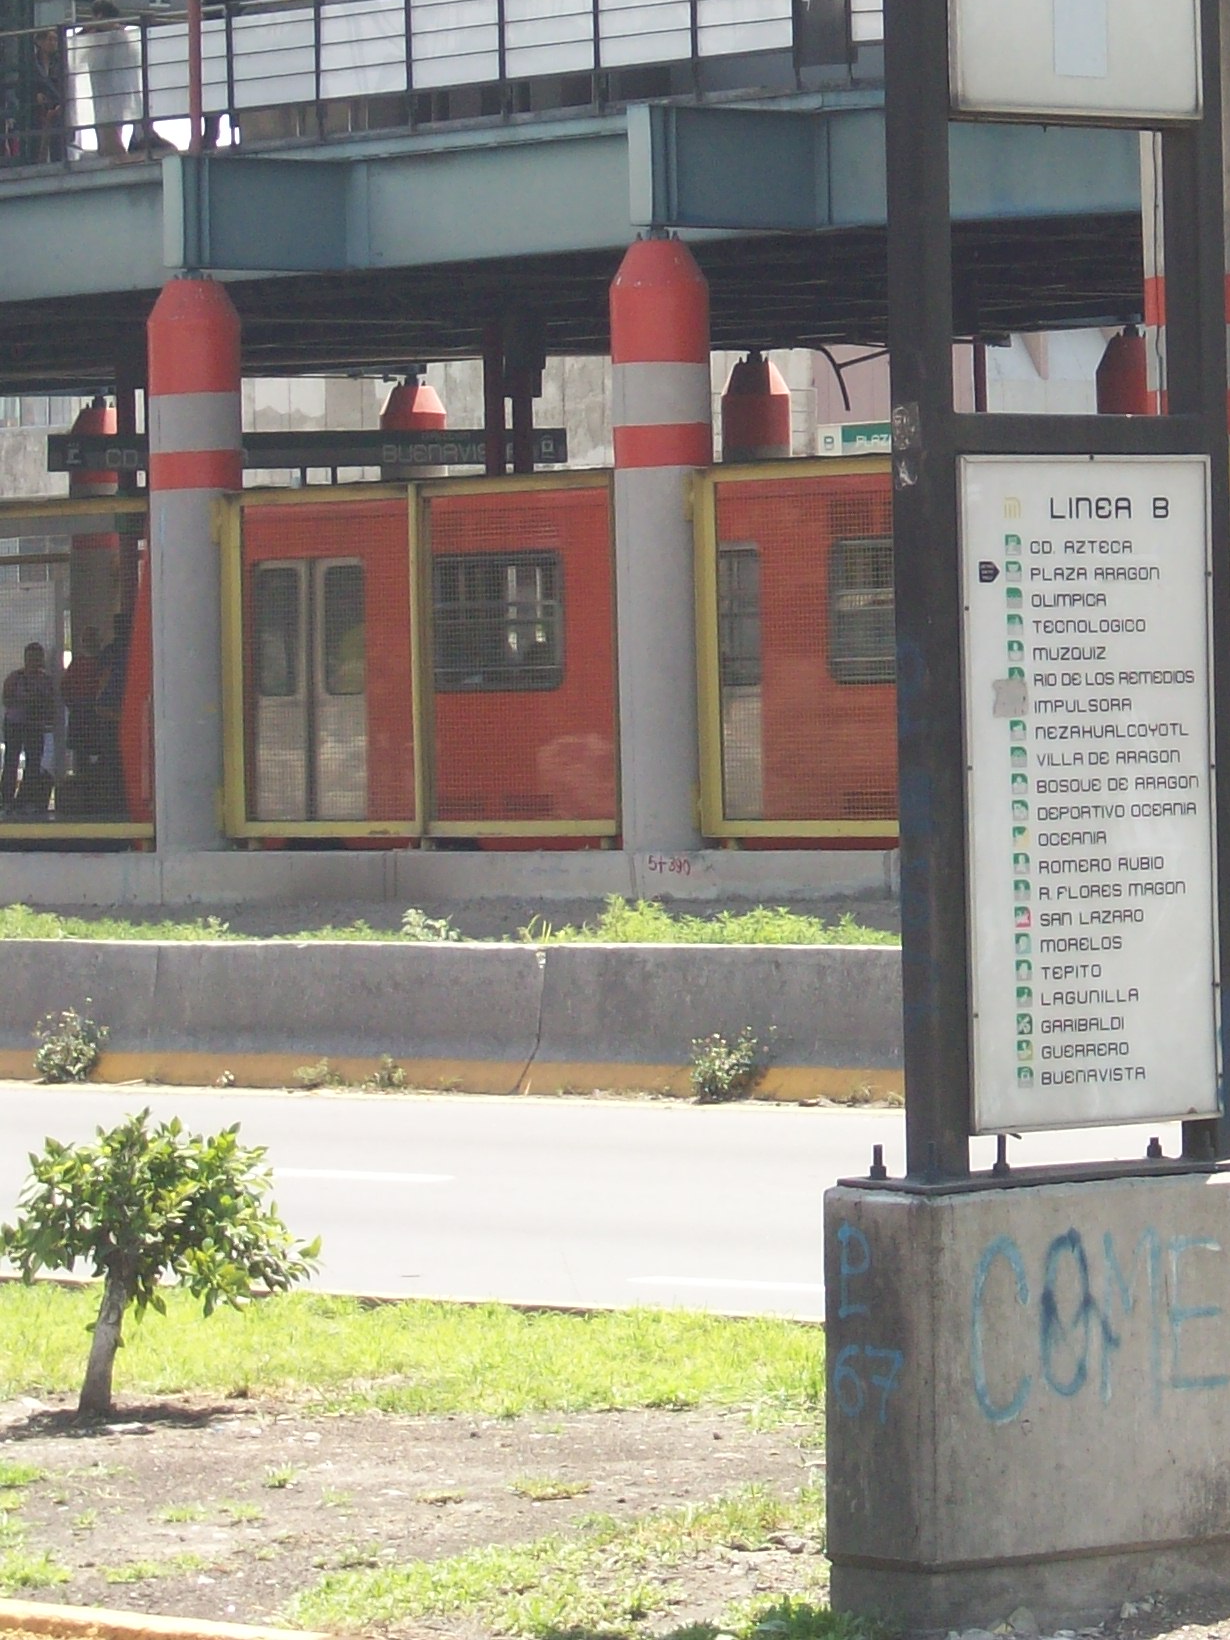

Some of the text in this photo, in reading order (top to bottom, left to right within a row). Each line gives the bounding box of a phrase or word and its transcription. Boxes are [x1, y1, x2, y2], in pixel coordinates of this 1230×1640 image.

[1050, 496, 1169, 520] LINEA B
[1063, 540, 1133, 555] AZTECA
[1030, 566, 1160, 582] PLAZA ARAGON
[1031, 592, 1107, 608] OLIMPICA
[1031, 618, 1146, 634] TECNOLOGICO
[1033, 670, 1195, 687] RIO DE LOS REMEDIOS
[1034, 697, 1132, 714] IMPULSORA
[1035, 722, 1189, 740] NEZAHUALCOYOTL
[1036, 749, 1181, 767] VILLA DE ARAGON
[1107, 777, 1129, 792] DE
[1134, 775, 1199, 790] ARAGON
[1037, 801, 1197, 821] DEPORTIVO OCEANIA
[1037, 830, 1107, 847] OCEANIA
[1038, 855, 1165, 875] ROMERO RUBIO
[1056, 883, 1122, 900] FLORES
[1128, 880, 1186, 897] MAGON
[1039, 908, 1144, 927] SAN LAZARO
[1040, 935, 1123, 953] MORELOS
[1040, 963, 1102, 980] TEPITO
[1040, 987, 1139, 1007] LAGUNILLA
[1040, 1016, 1125, 1034] GARIBALDI
[1041, 1041, 1130, 1060] GUERRERO
[1040, 1066, 1146, 1086] BUENAVISTA
[832, 1342, 904, 1426] 67
